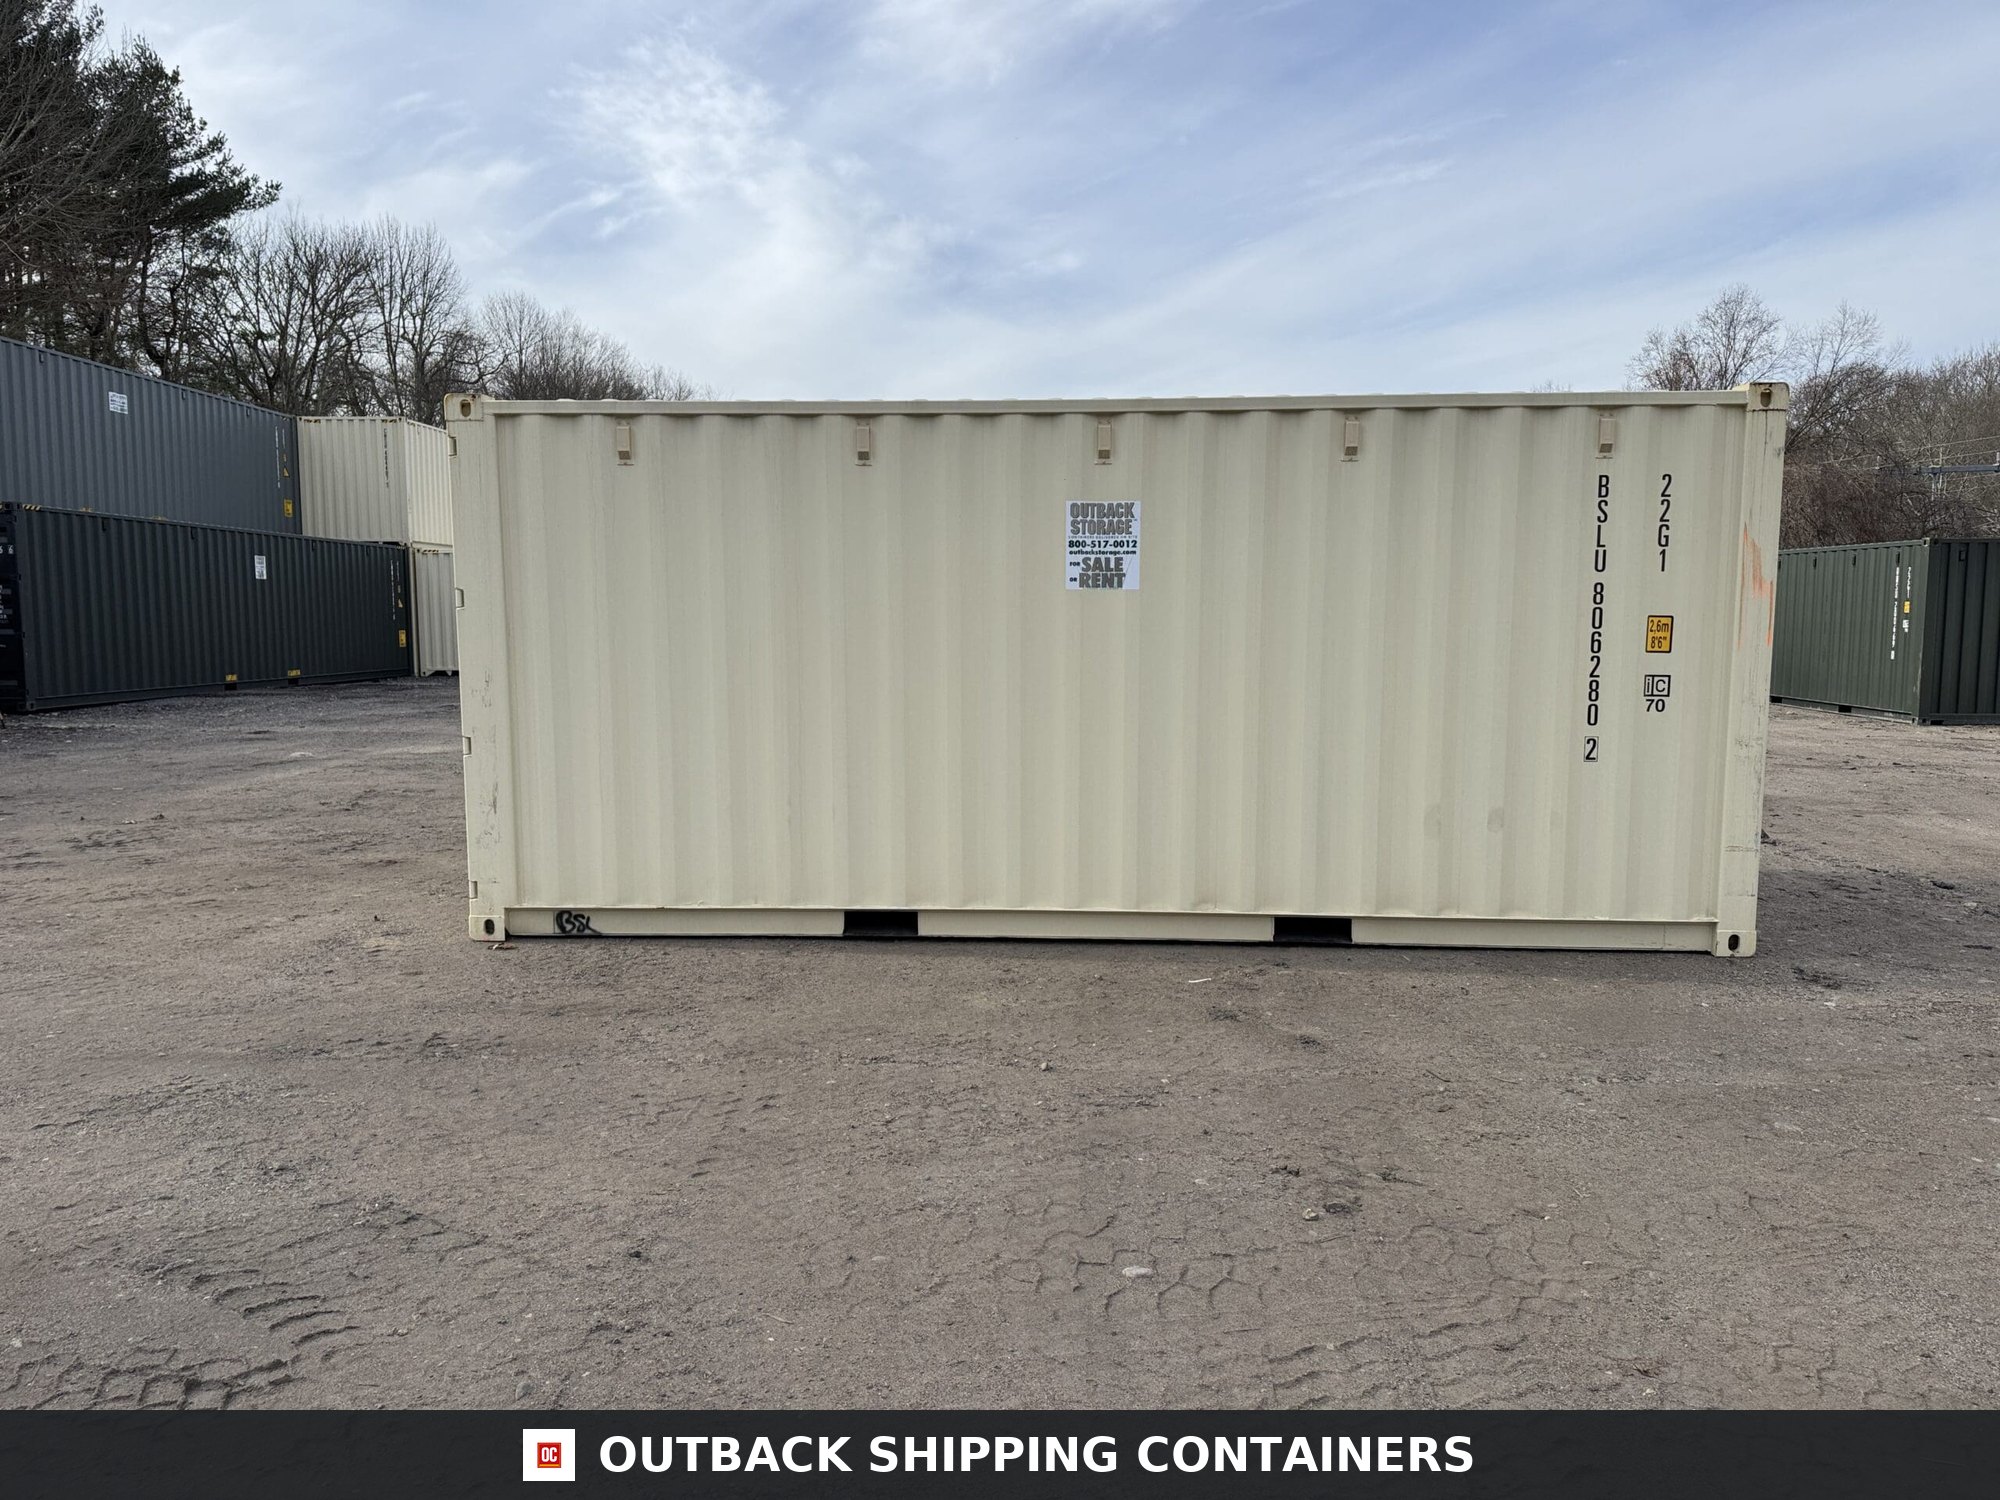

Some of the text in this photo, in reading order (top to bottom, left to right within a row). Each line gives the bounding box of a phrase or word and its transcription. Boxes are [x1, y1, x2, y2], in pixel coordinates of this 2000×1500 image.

[1070, 502, 1135, 518] OUTBACK
[1070, 519, 1132, 535] STORAGE
[1658, 473, 1672, 572] 22G1
[1068, 540, 1138, 548] 800-517-0012
[1081, 556, 1123, 572] SALE
[1079, 572, 1126, 588] RENT
[1585, 474, 1610, 760] BSLU 806280 2
[1645, 699, 1666, 713] 70
